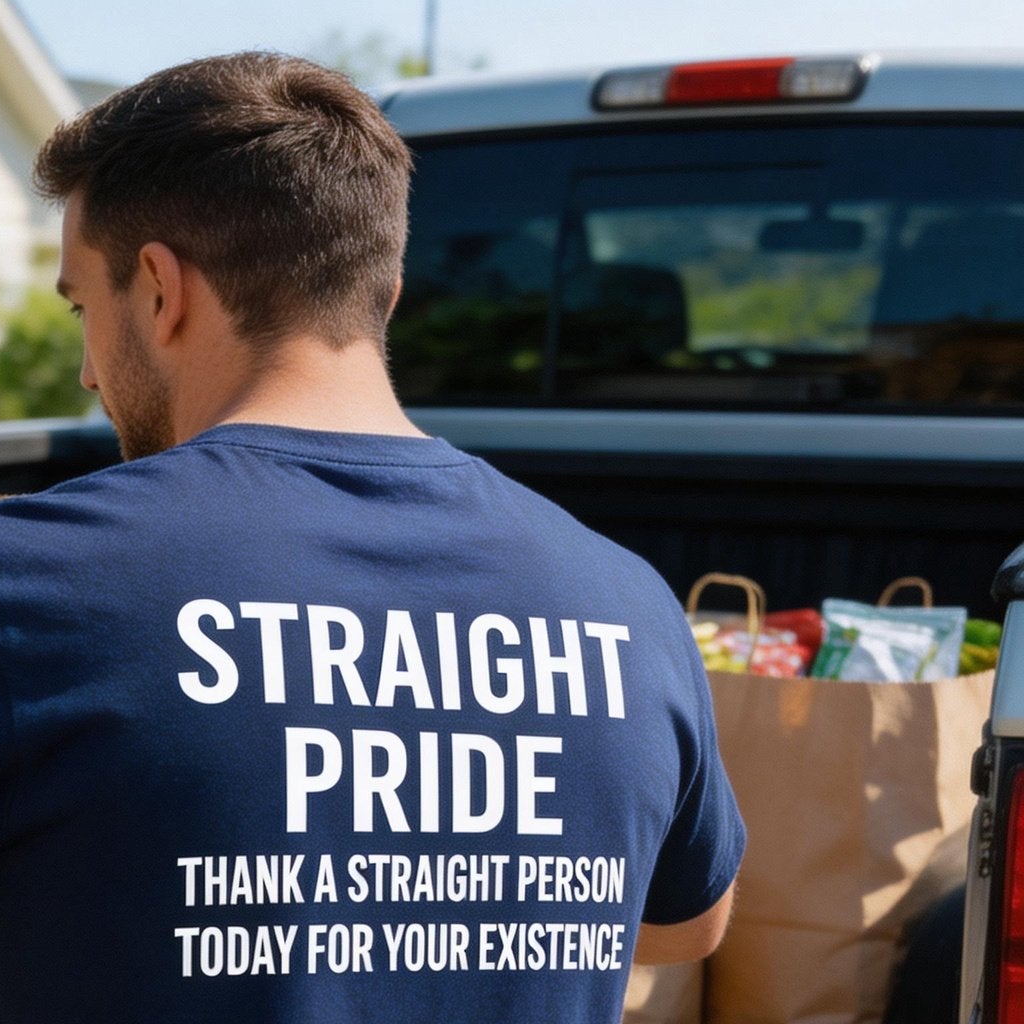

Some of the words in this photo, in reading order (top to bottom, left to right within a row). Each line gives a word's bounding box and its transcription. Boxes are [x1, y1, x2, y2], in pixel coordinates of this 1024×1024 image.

[176, 598, 631, 720] STRAIGHT
[284, 726, 563, 836] PRIDE
[177, 854, 306, 907] THANK
[313, 854, 338, 903] A
[347, 854, 510, 903] STRAIGHT
[517, 855, 626, 904] PERSON
[174, 924, 299, 977] TODAY
[307, 923, 374, 974] FOR
[382, 923, 470, 972] YOUR
[478, 922, 626, 972] EXISTENCE
